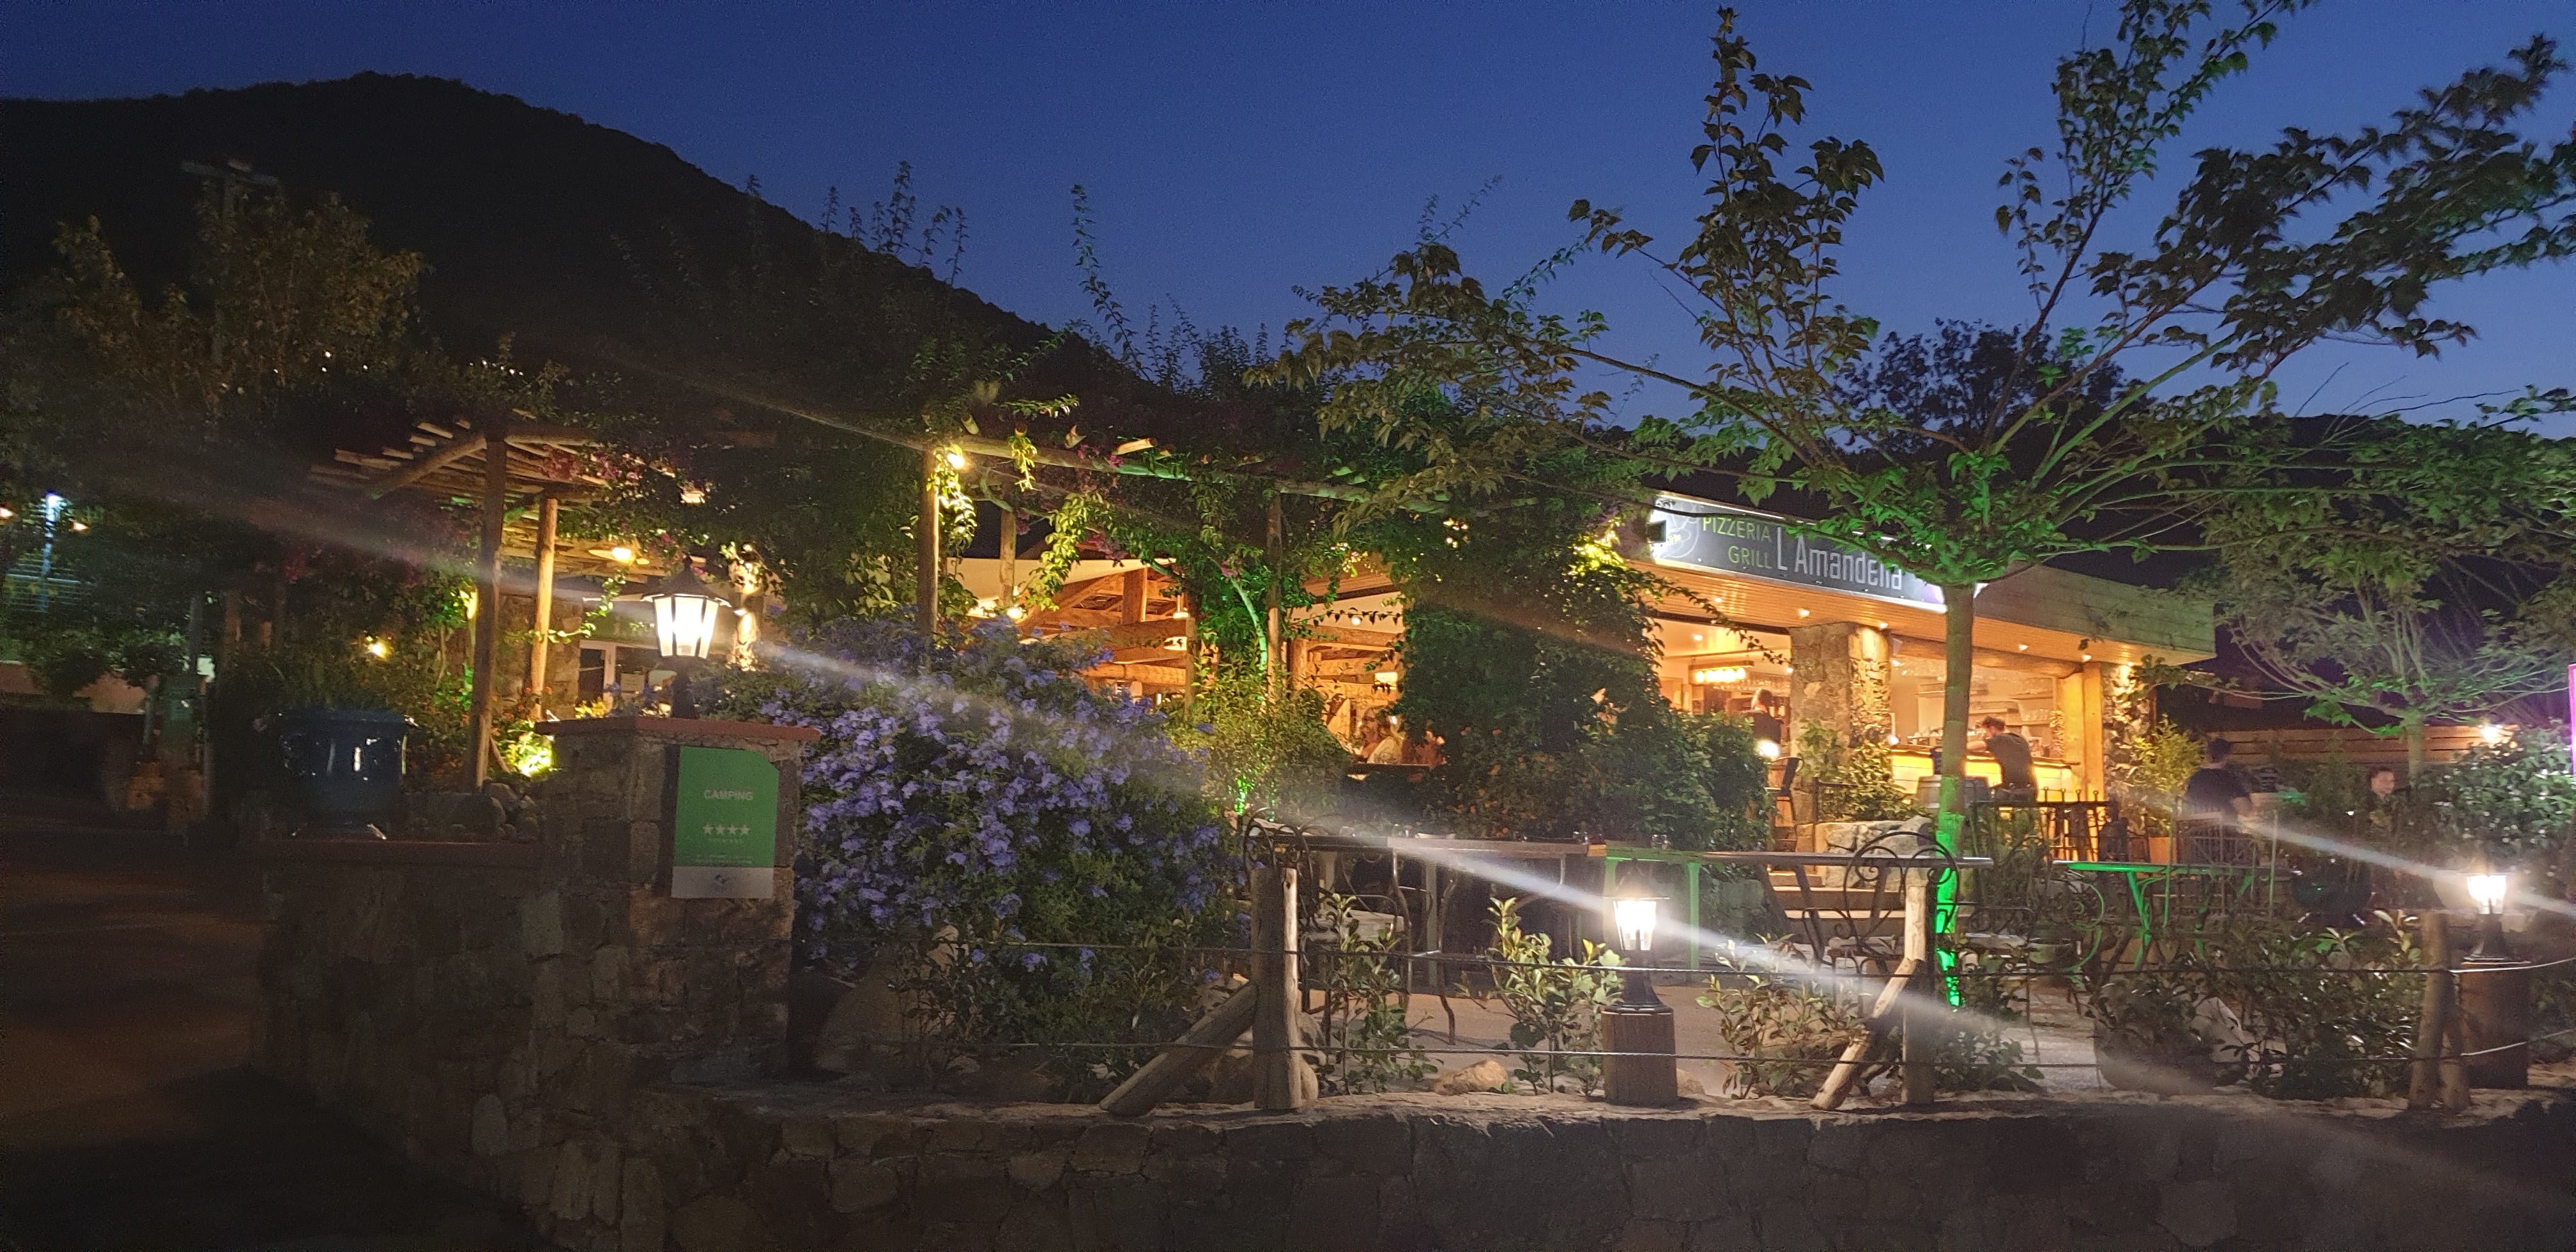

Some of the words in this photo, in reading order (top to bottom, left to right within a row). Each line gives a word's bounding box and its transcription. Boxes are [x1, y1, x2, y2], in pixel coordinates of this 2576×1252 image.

[1703, 516, 1772, 542] PIZZERIA
[1728, 546, 1772, 569] GRILL
[704, 790, 754, 800] CAMPING
